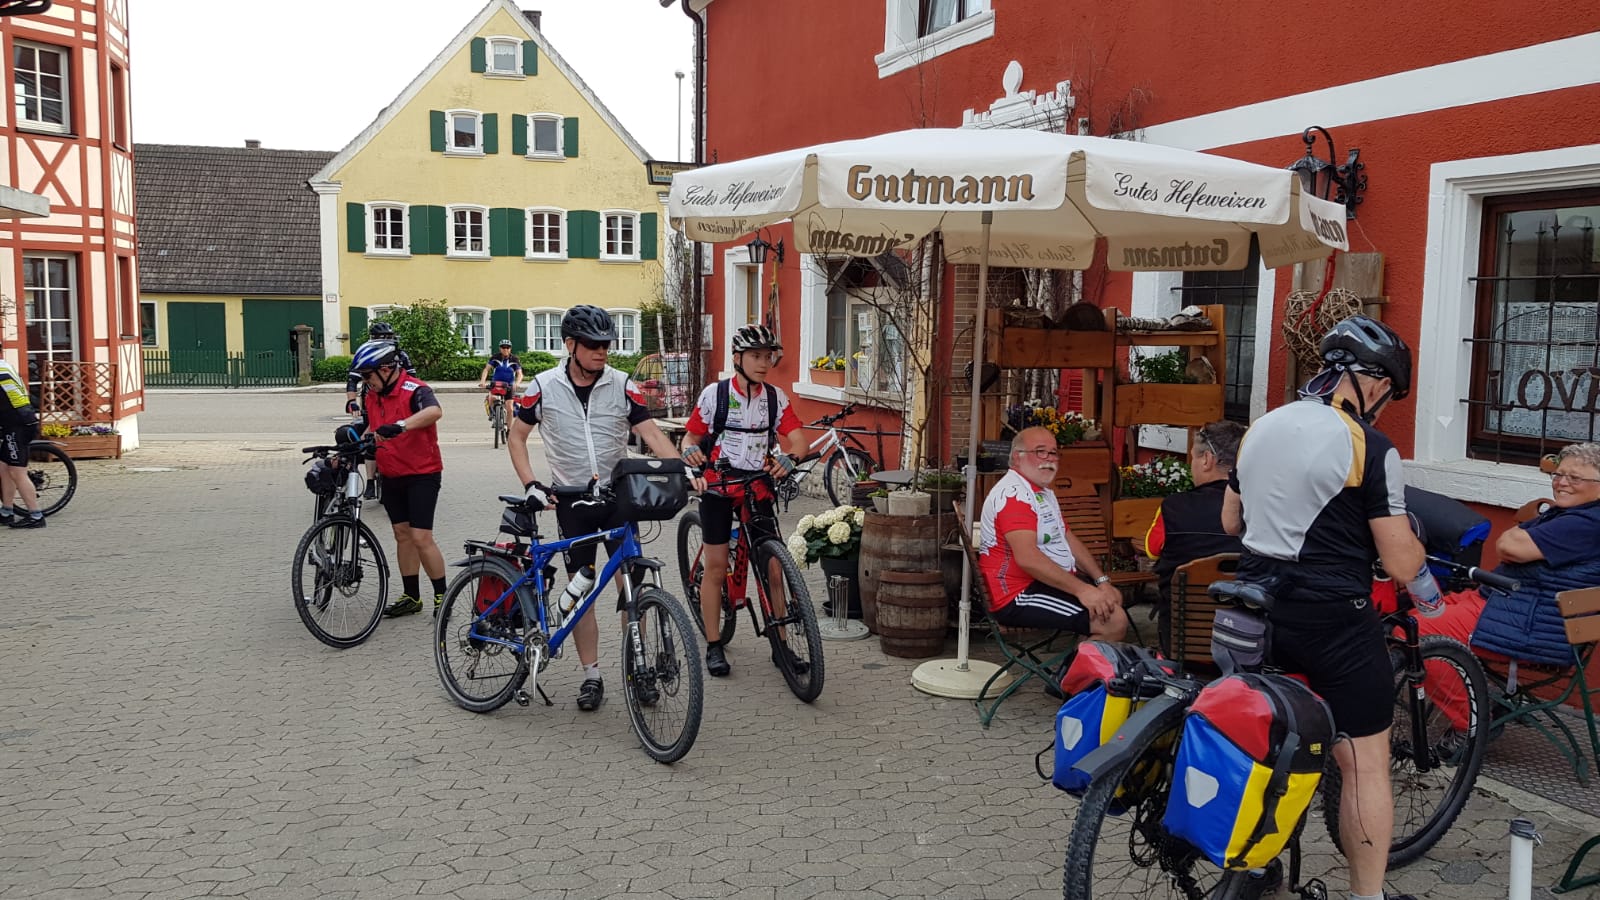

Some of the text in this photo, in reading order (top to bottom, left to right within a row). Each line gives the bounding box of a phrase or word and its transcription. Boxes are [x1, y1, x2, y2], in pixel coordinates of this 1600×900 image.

[682, 184, 719, 206] Gutes
[847, 164, 1036, 204] Gutmann
[1113, 172, 1267, 212] Gutes Hefeweizen
